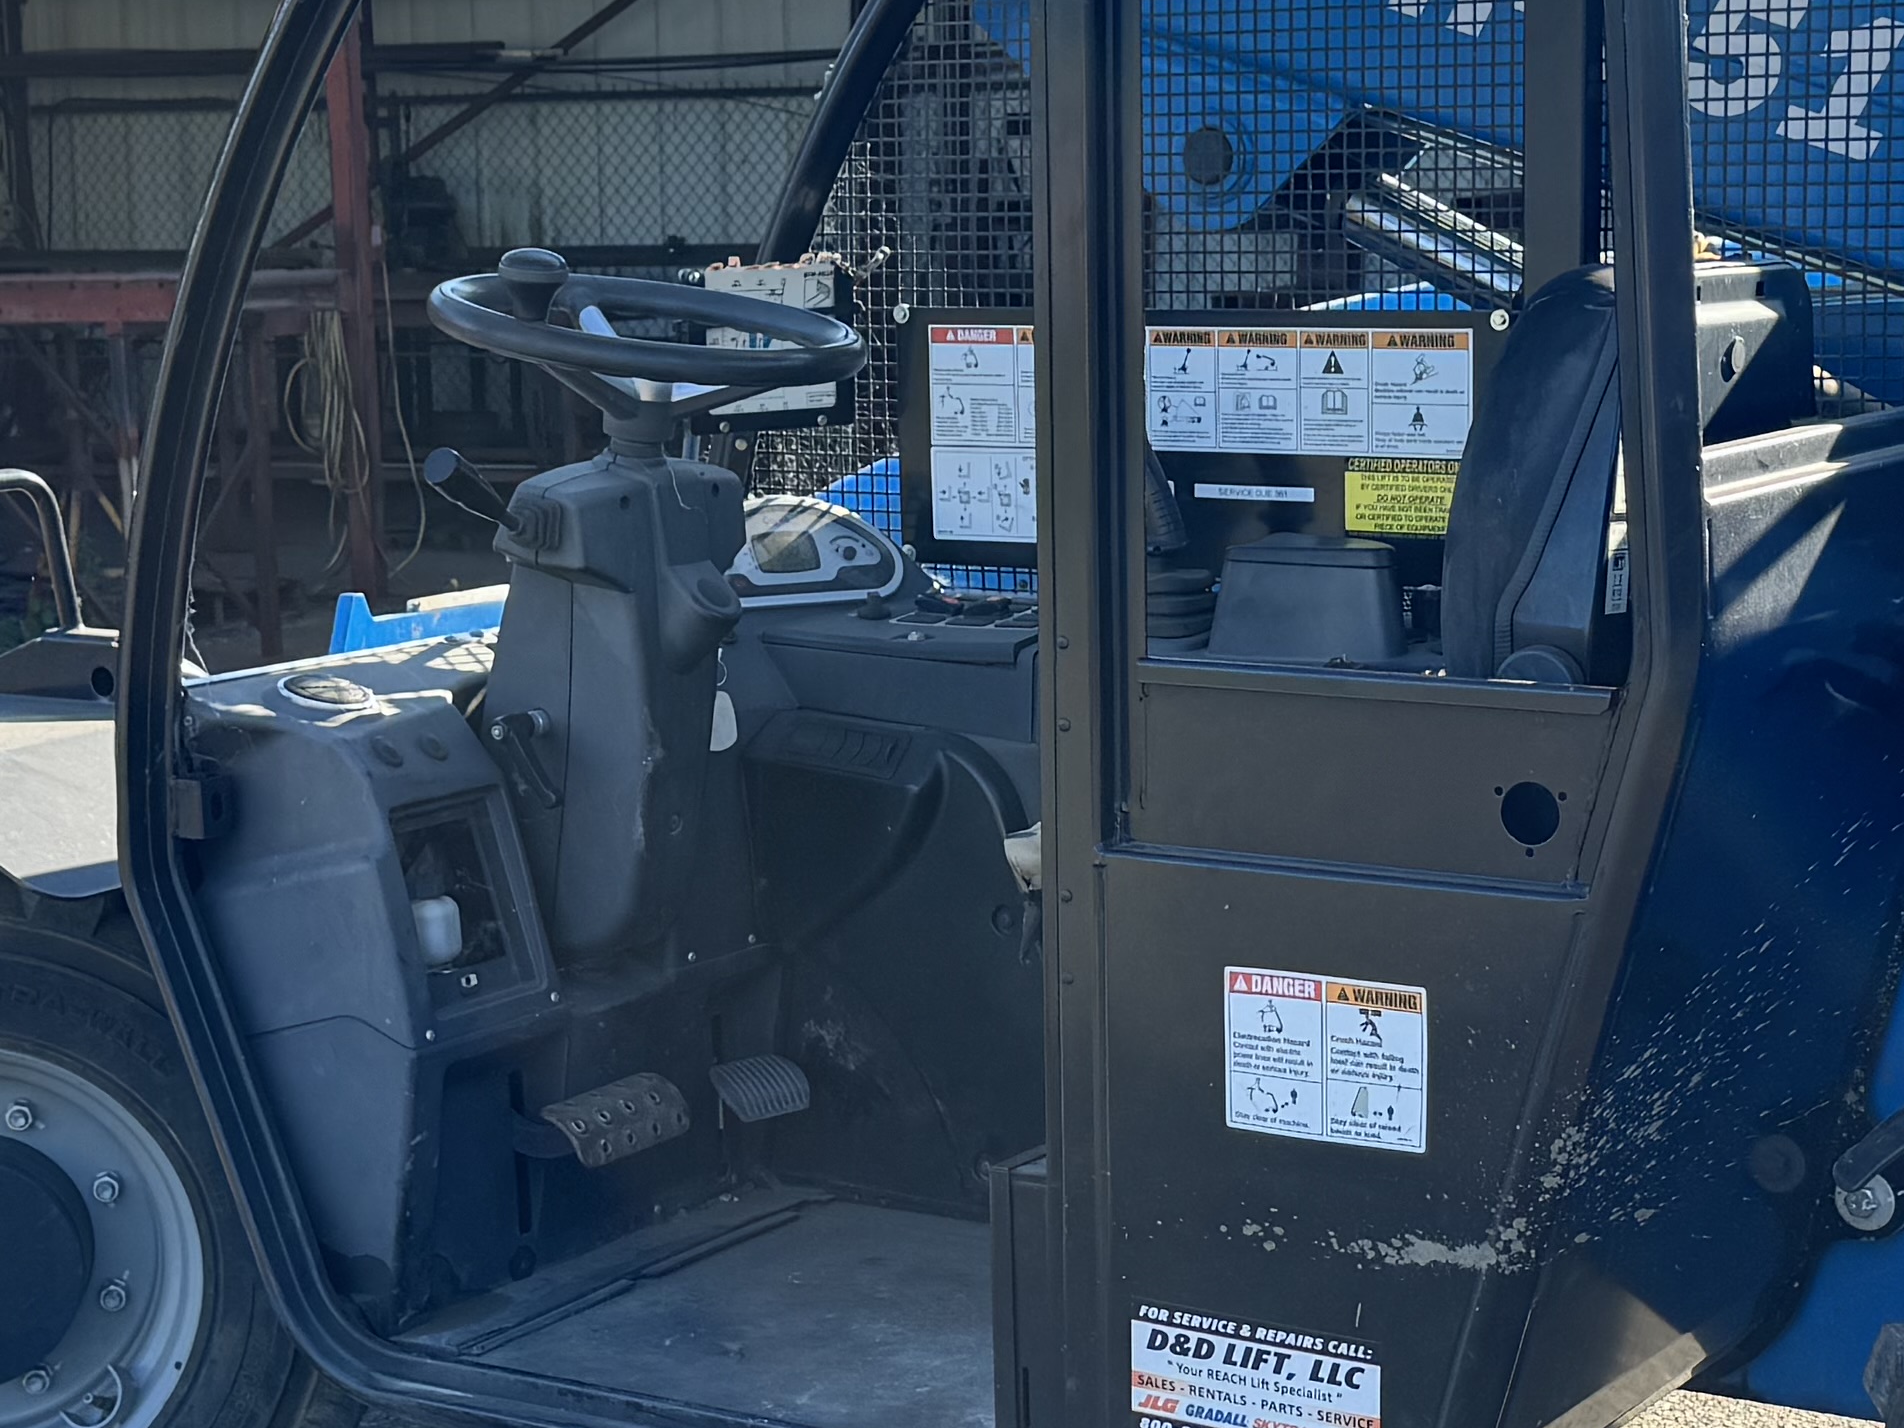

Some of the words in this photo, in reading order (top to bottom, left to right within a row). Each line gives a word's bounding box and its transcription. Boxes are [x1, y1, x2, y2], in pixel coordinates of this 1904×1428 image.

[957, 328, 996, 342] DANGER
[1161, 330, 1211, 345] WARNING
[1237, 331, 1288, 346] WARNING
[1314, 332, 1367, 347] WARNING
[1399, 334, 1456, 348] WARNING
[1348, 457, 1392, 472] CERTIFIED
[1394, 459, 1446, 473] OPERATORS
[1251, 975, 1316, 999] DANGER
[1352, 987, 1418, 1011] WARNING
[1138, 1304, 1170, 1322] FOR
[1172, 1311, 1238, 1334] SERVICE
[1239, 1324, 1251, 1337] &
[1255, 1326, 1324, 1351] REPAIRS
[1327, 1340, 1373, 1360] CALL:
[1146, 1328, 1216, 1360] D&D
[1222, 1342, 1296, 1381] LIFT,
[1308, 1358, 1366, 1390] LLC
[1176, 1362, 1203, 1378] Your
[1207, 1368, 1247, 1386] REACH
[1250, 1377, 1270, 1392] Lift
[1273, 1381, 1333, 1403] Specialist
[1137, 1374, 1176, 1392] SALES
[1188, 1384, 1247, 1406] RENTALS
[1261, 1399, 1303, 1417] PARTS
[1138, 1394, 1180, 1414] JLG
[1185, 1404, 1248, 1428] GRADALL
